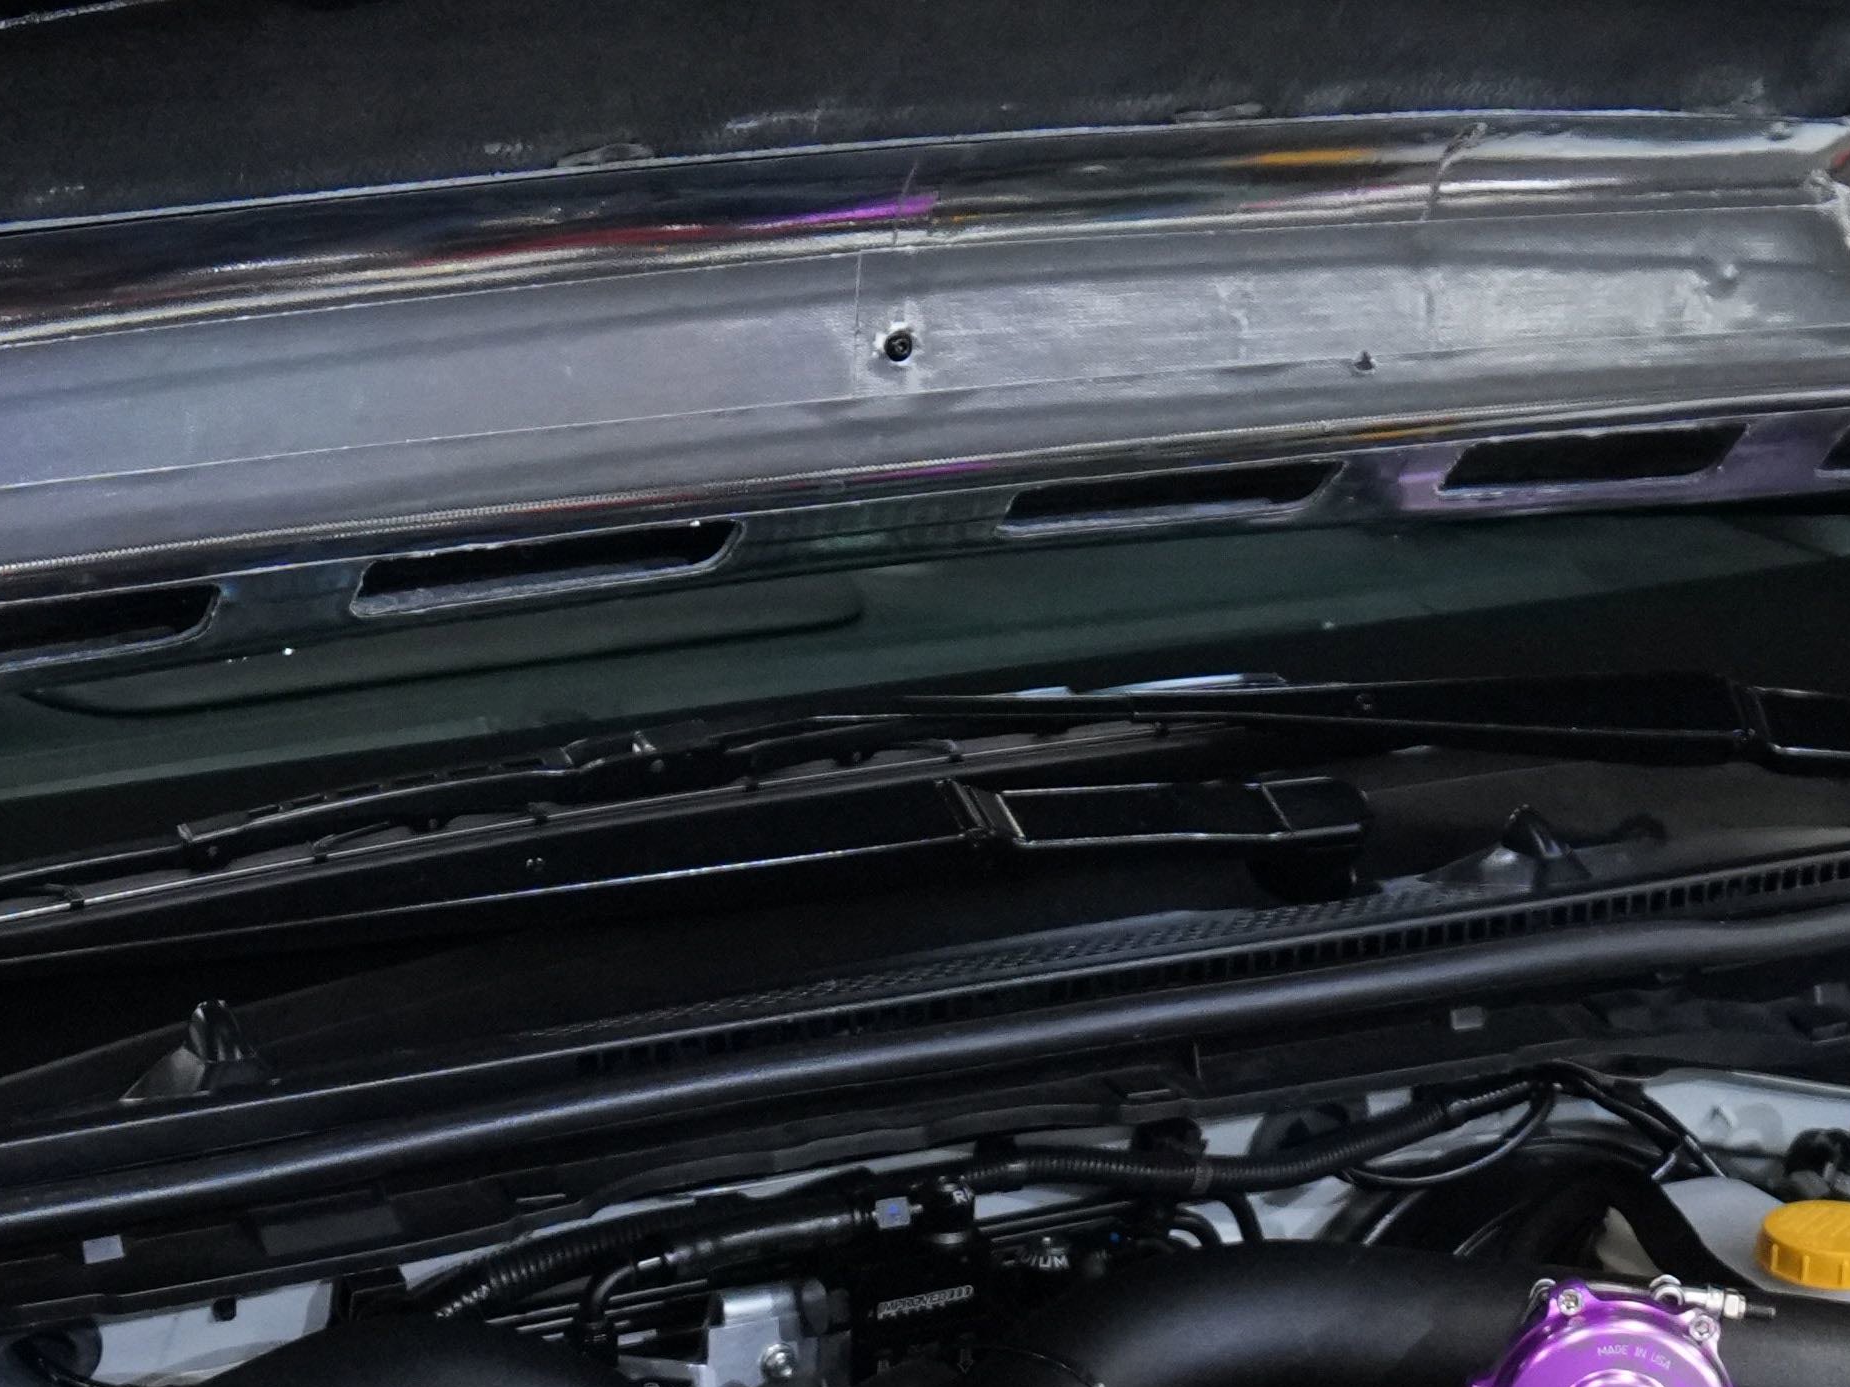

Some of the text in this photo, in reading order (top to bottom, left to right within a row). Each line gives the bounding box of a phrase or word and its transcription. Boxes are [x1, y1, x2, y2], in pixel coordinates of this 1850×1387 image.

[1598, 1344, 1671, 1371] MADE IN USA
